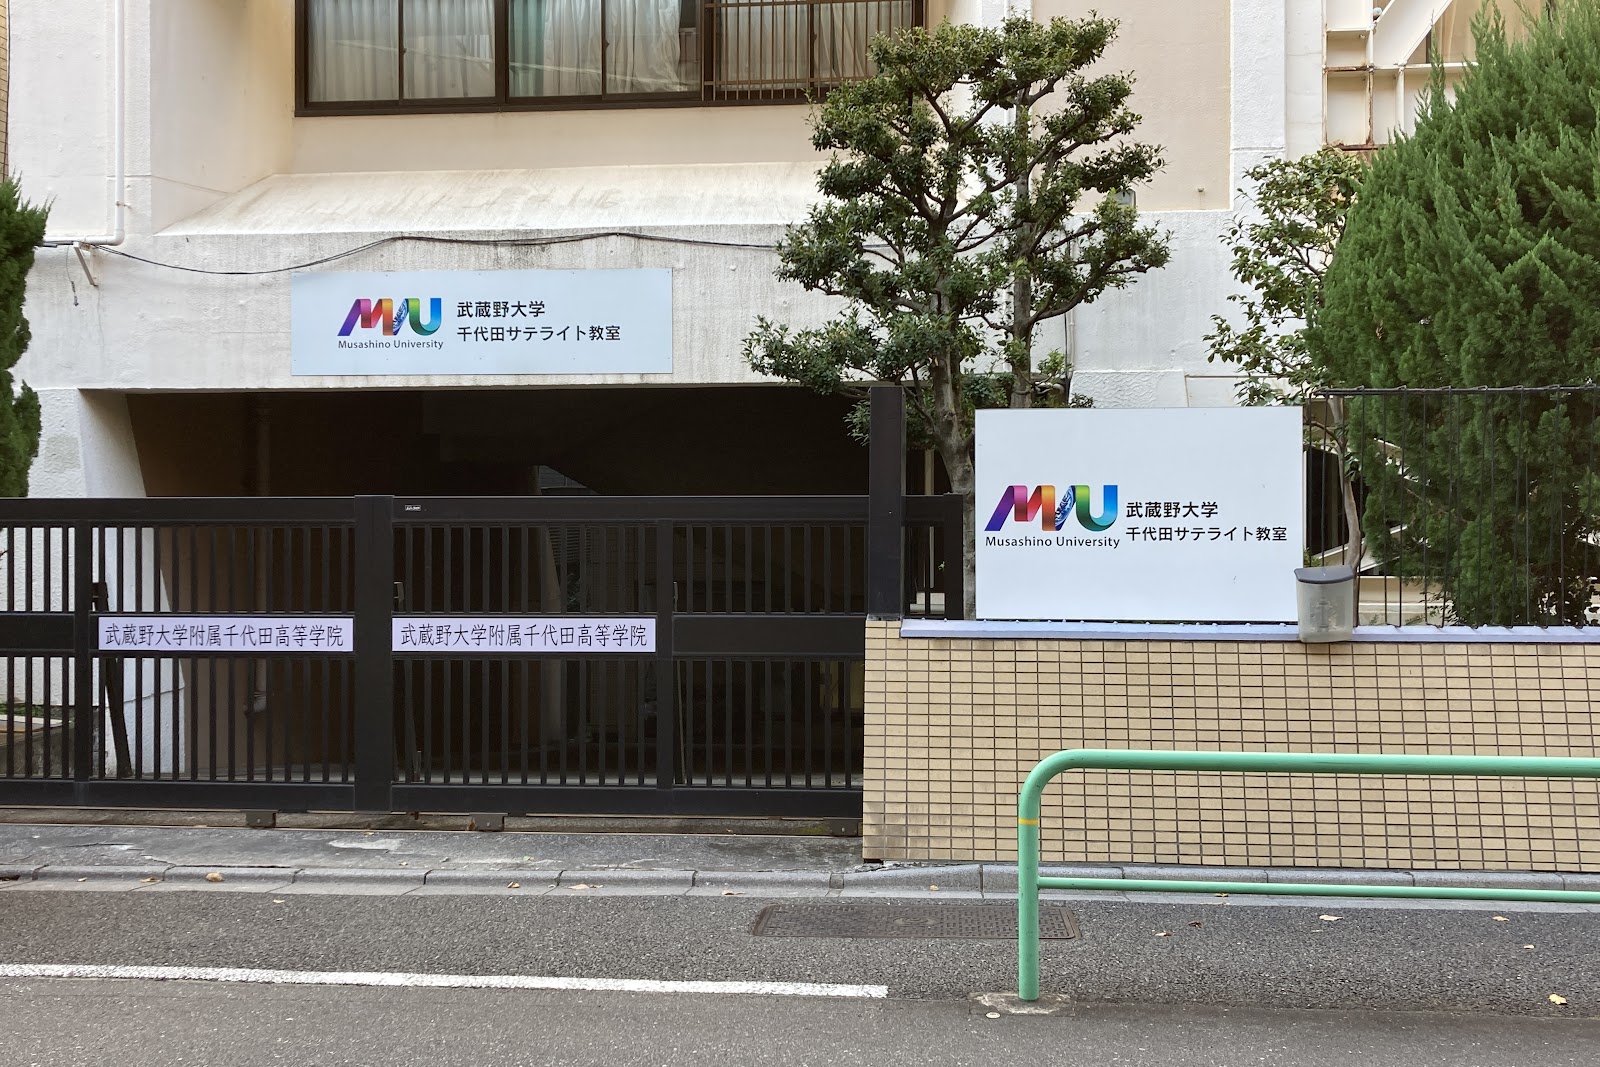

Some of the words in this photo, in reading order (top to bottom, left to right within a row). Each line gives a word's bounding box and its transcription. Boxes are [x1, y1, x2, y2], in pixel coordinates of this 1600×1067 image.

[456, 300, 546, 318] 武蔵野大学
[456, 325, 621, 342] 千代田サテライト教室
[338, 340, 391, 349] Musashino
[393, 340, 444, 351] University
[1125, 501, 1219, 518] 武蔵野大学
[1125, 526, 1288, 541] 千代田サテライト教室
[985, 536, 1053, 547] Musashino
[1056, 536, 1121, 549] University
[105, 622, 344, 647] 武蔵野大学附属千代田高等学院
[400, 622, 648, 647] 武蔵野大学附属千代田高等学院
